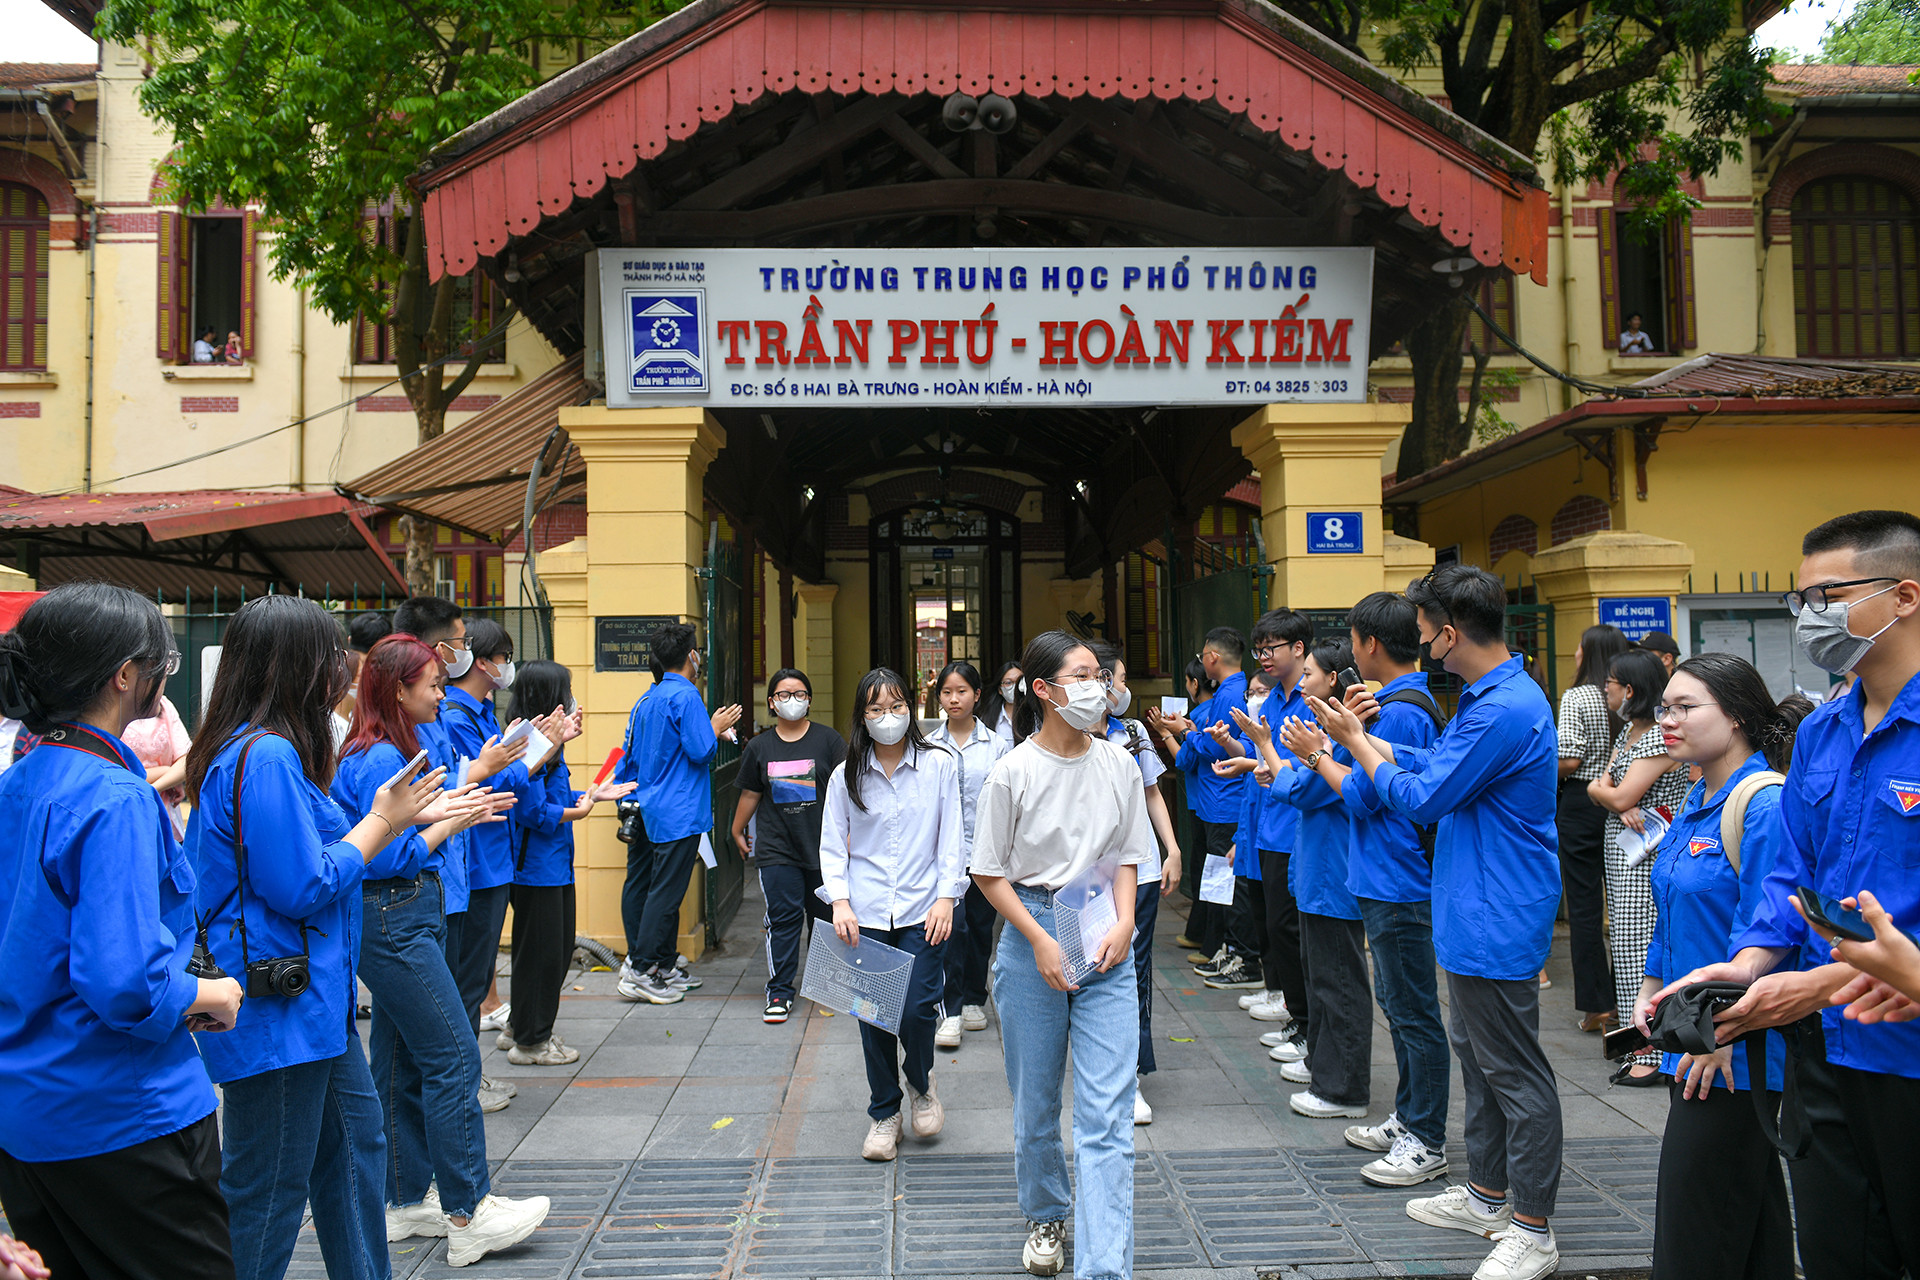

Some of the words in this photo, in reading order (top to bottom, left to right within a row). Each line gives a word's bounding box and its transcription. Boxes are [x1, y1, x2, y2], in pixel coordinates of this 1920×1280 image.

[652, 261, 667, 272] DỤC
[759, 258, 899, 291] TRƯỜNG
[912, 265, 1028, 290] TRUNG
[1042, 265, 1109, 295] HỌC
[1123, 255, 1190, 289] PHỔ
[1204, 261, 1317, 289] THÔNG
[623, 272, 652, 281] THÀNH
[654, 272, 673, 281] PHỐ
[674, 272, 687, 281] HÀ
[688, 272, 705, 283] NỘI
[717, 294, 874, 366] TRẦN
[887, 302, 999, 366] PHÚ
[1039, 304, 1194, 366] HOÀN
[1206, 293, 1354, 364] KIẾM
[763, 377, 786, 396] SỐ
[791, 383, 799, 396] 8
[803, 382, 831, 396] HAI
[837, 379, 859, 395] BÀ
[864, 381, 920, 396] TRƯNG
[933, 379, 980, 395] HOÀN
[984, 377, 1023, 395] KIẾM
[1037, 378, 1060, 394] HÀ
[1065, 379, 1092, 396] NỘI
[1226, 381, 1250, 393] ĐT:
[1254, 380, 1271, 393] 04
[1276, 380, 1310, 393] 3825
[1324, 517, 1344, 541] 8
